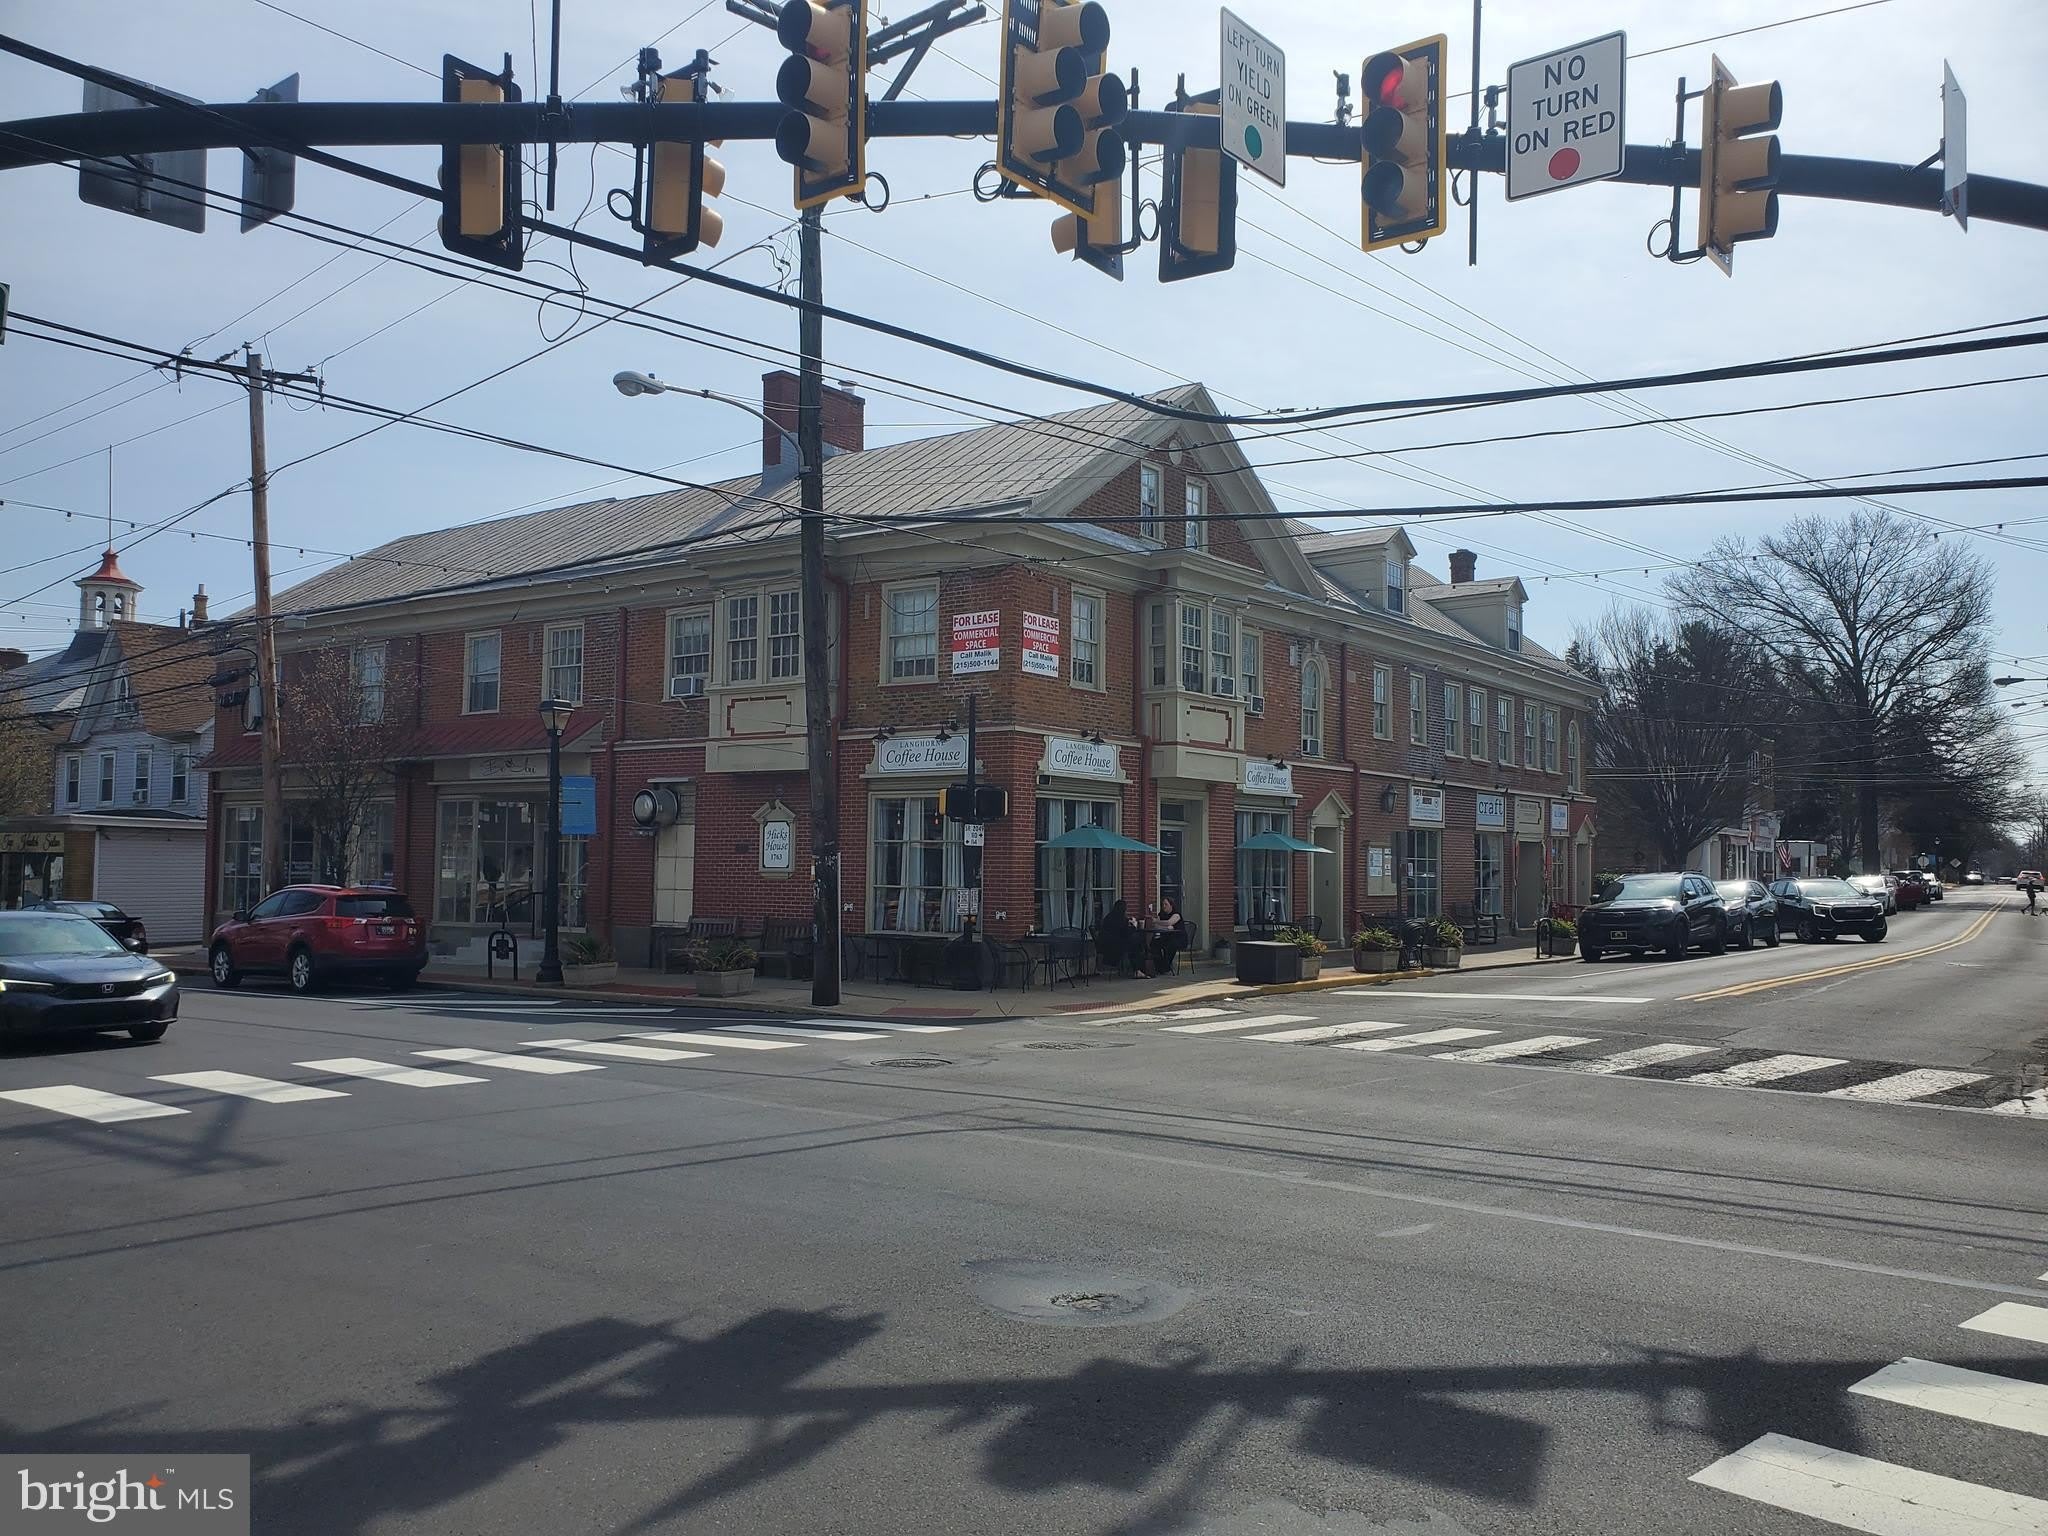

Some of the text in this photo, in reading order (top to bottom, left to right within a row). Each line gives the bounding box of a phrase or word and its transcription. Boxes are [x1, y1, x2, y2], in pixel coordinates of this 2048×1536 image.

[1227, 25, 1280, 78] LEFT TURN
[1236, 58, 1271, 100] YIELD
[1545, 55, 1586, 89] NO
[1228, 83, 1279, 131] ON GREEN
[1532, 83, 1599, 121] TURN
[1515, 110, 1616, 155] ON RED
[954, 612, 999, 627] FOR LEASE
[1023, 614, 1059, 631] FOR LEASE
[953, 627, 999, 641] COMMERCIAL
[1023, 628, 1059, 645] COMMERCIAL
[965, 639, 987, 650] SPACE
[1032, 641, 1050, 653] SPACE
[974, 650, 992, 658] Malik
[1028, 651, 1039, 659] Call
[953, 659, 999, 671] (215)500-1144
[886, 748, 961, 766] Coffee House
[1054, 749, 1111, 769] Coffee House
[1247, 770, 1287, 786] Coffee House
[1479, 798, 1503, 815] craft
[766, 828, 788, 840] Hicks
[765, 840, 788, 851] House
